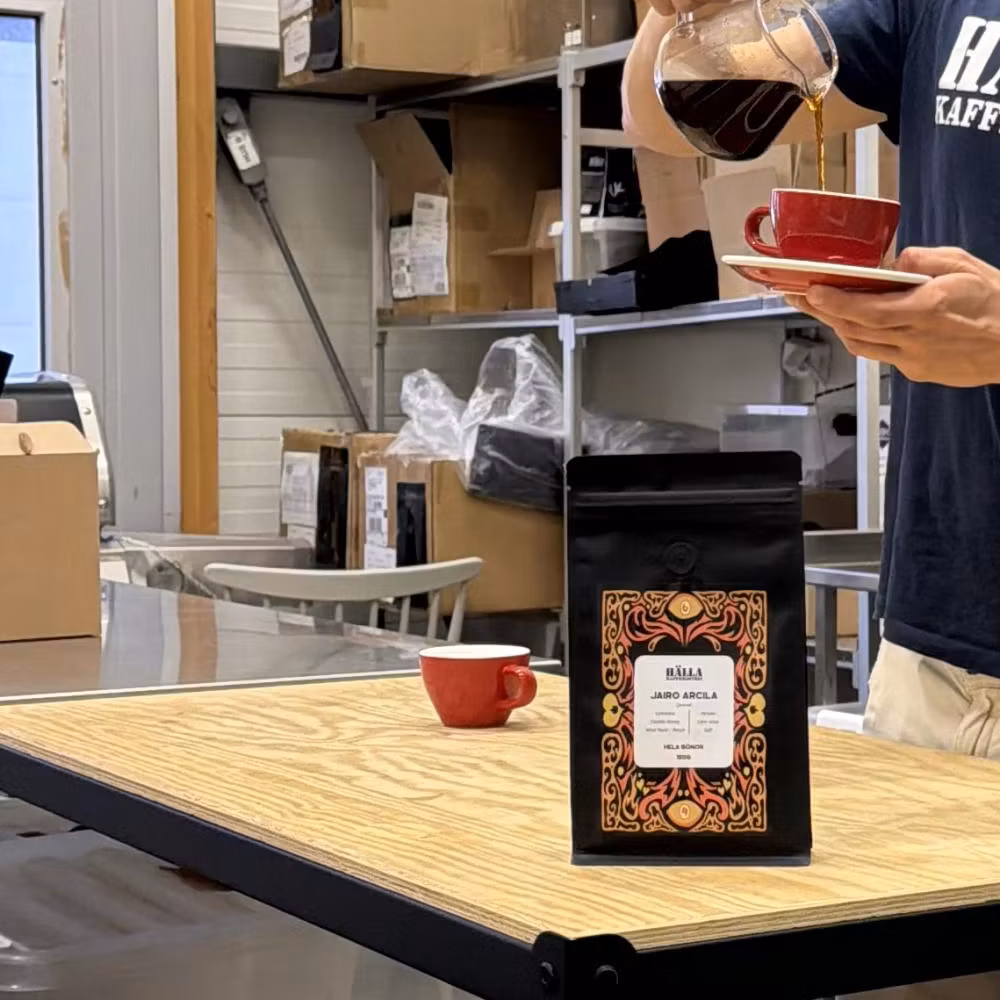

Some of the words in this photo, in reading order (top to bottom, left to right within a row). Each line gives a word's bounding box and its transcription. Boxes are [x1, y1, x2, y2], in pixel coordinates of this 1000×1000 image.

[665, 664, 703, 677] HÄLLA
[650, 691, 680, 700] JAIRO
[682, 691, 718, 700] ARCILA
